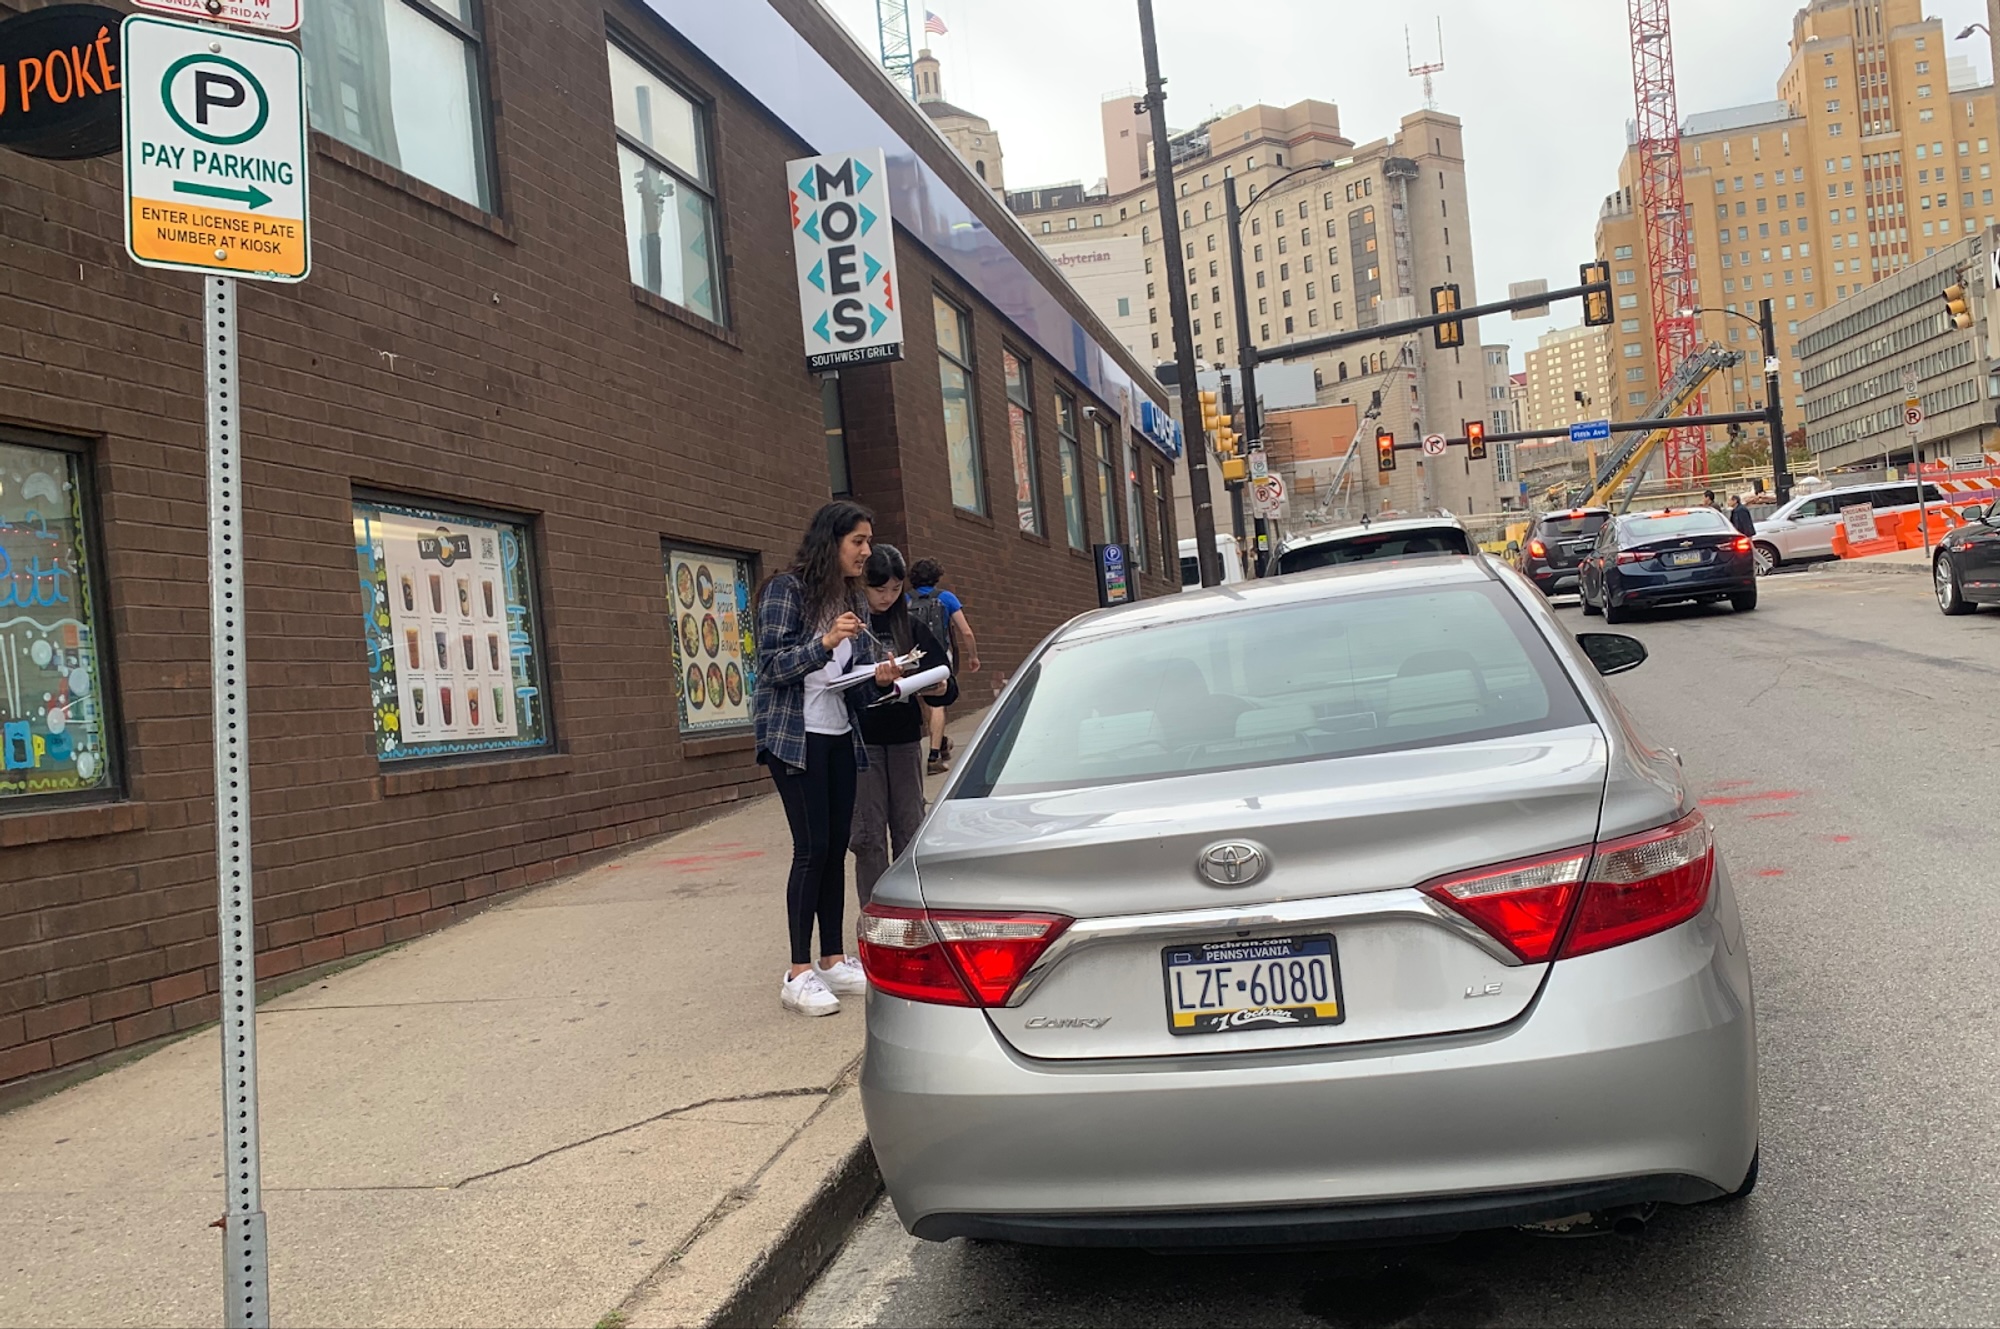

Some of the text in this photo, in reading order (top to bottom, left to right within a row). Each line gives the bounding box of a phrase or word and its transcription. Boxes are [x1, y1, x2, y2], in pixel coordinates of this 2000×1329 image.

[220, 5, 270, 20] FRIDAY
[19, 25, 122, 112] POKÉ
[195, 70, 245, 125] P
[142, 142, 293, 185] PAY PARKING
[142, 207, 295, 239] ENTER LICENSE PLATE
[157, 227, 282, 255] NUMBER AT KIOSK
[815, 157, 867, 344] MOES
[811, 349, 866, 367] SOUTHWEST
[458, 541, 467, 553] 12
[1202, 938, 1292, 951] Cochran.com
[1206, 946, 1290, 961] PENNSYLVANIA
[1463, 982, 1503, 999] LE
[1024, 1016, 1112, 1030] CAMRY
